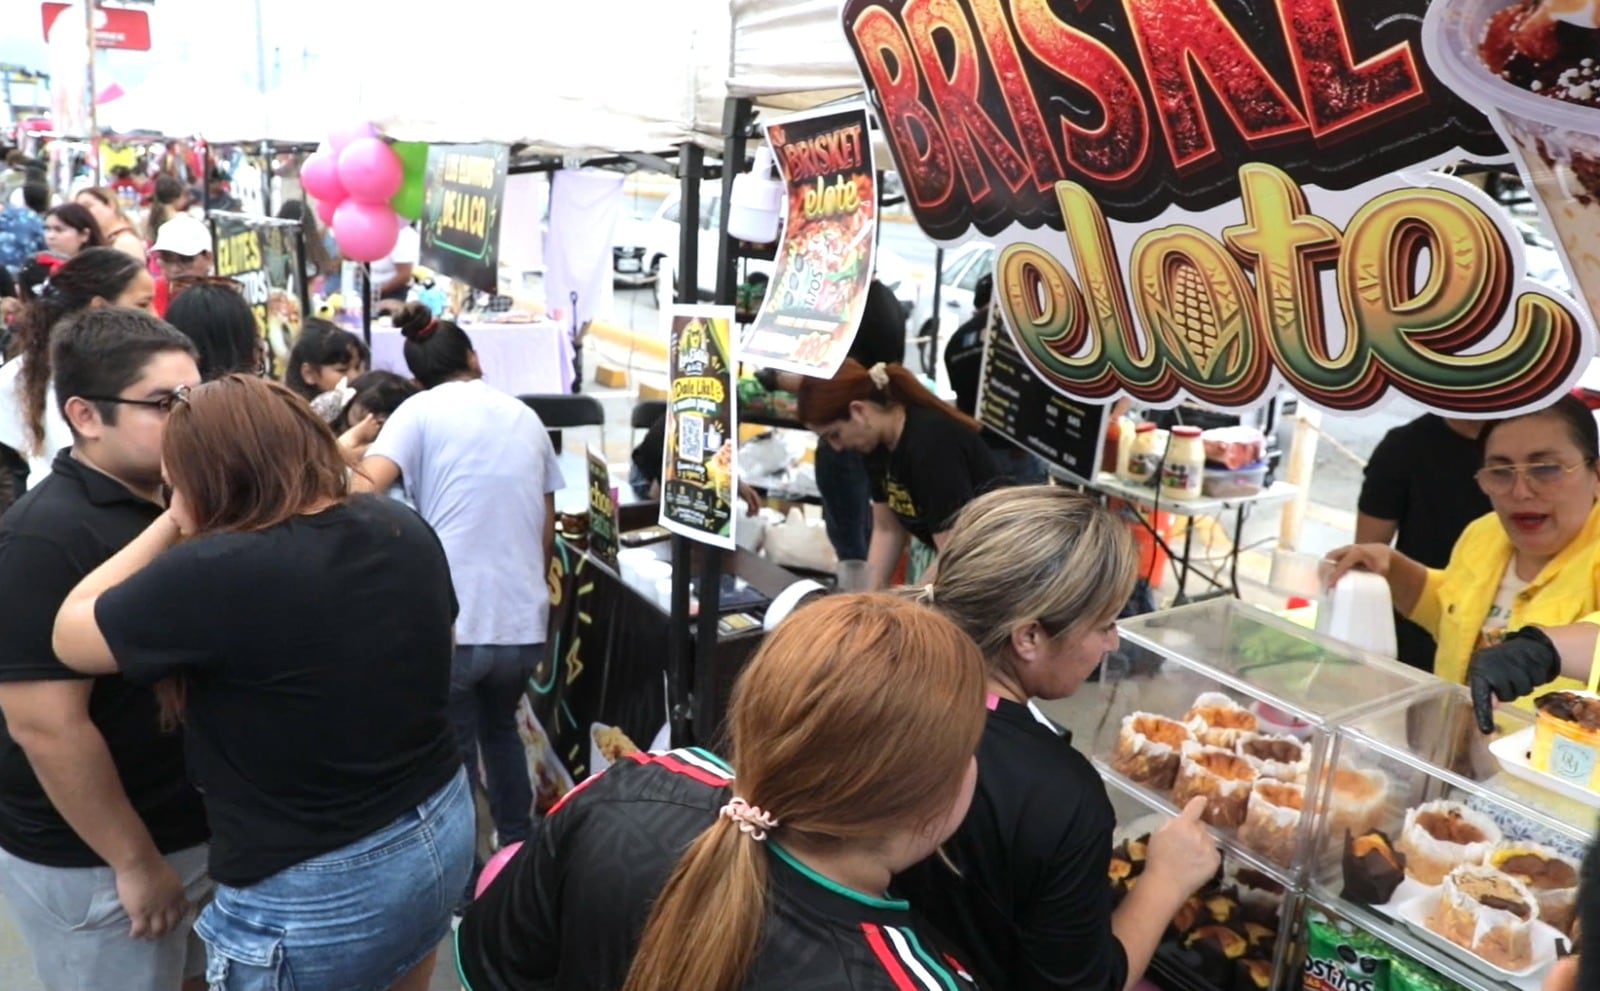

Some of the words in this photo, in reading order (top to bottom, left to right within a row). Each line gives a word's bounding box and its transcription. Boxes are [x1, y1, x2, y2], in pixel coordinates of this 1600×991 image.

[783, 123, 862, 182] BRISKET
[804, 174, 860, 220] elote
[1000, 163, 1582, 410] elote
[674, 379, 695, 398] Dale
